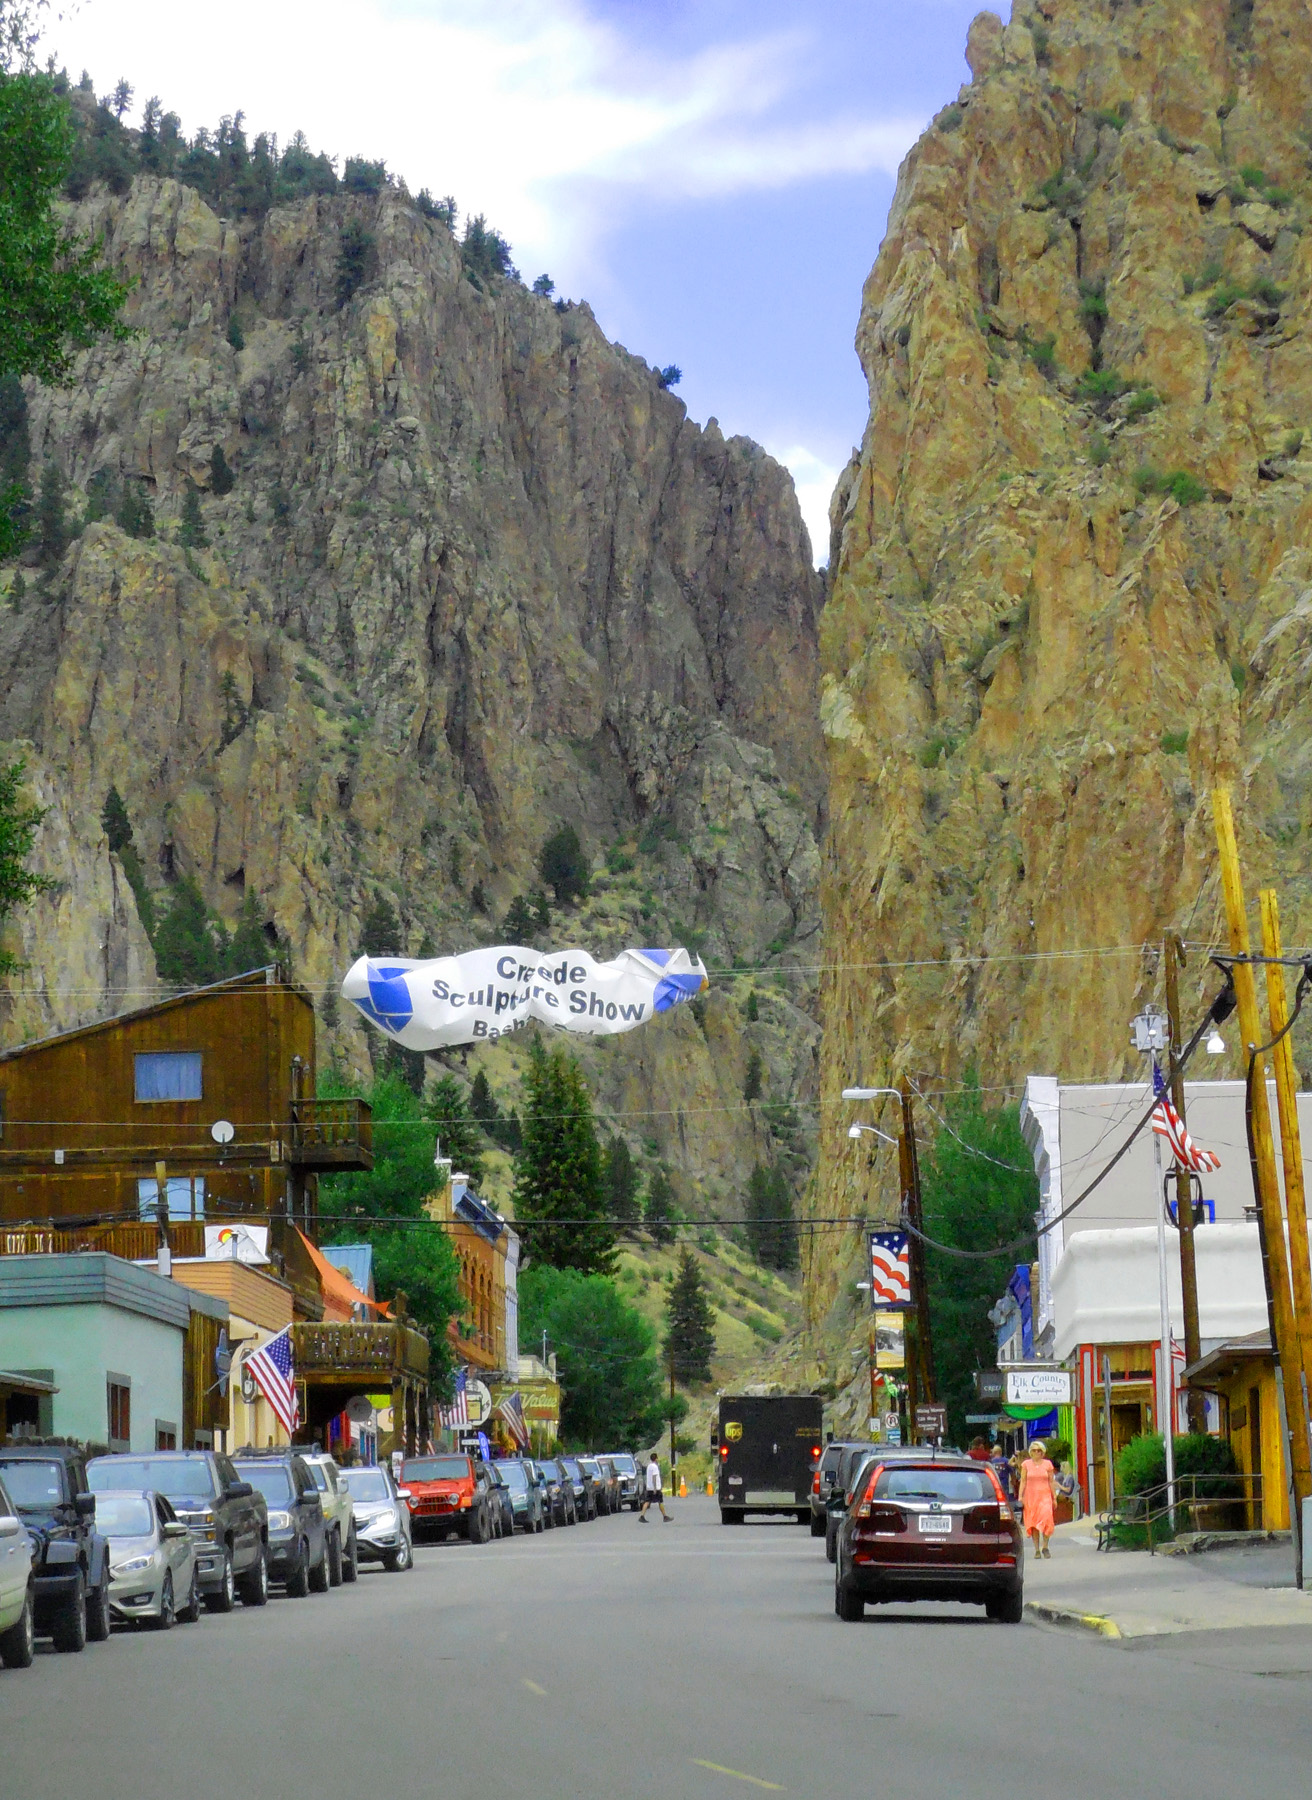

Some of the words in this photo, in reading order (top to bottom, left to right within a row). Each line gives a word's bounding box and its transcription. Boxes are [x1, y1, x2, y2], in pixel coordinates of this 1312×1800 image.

[496, 955, 587, 985] Creede
[432, 979, 560, 1015] Sculpture
[569, 989, 646, 1021] Show
[1012, 1374, 1028, 1388] Elk
[1031, 1374, 1067, 1388] Country
[519, 1393, 557, 1408] Value
[726, 1428, 741, 1439] ups
